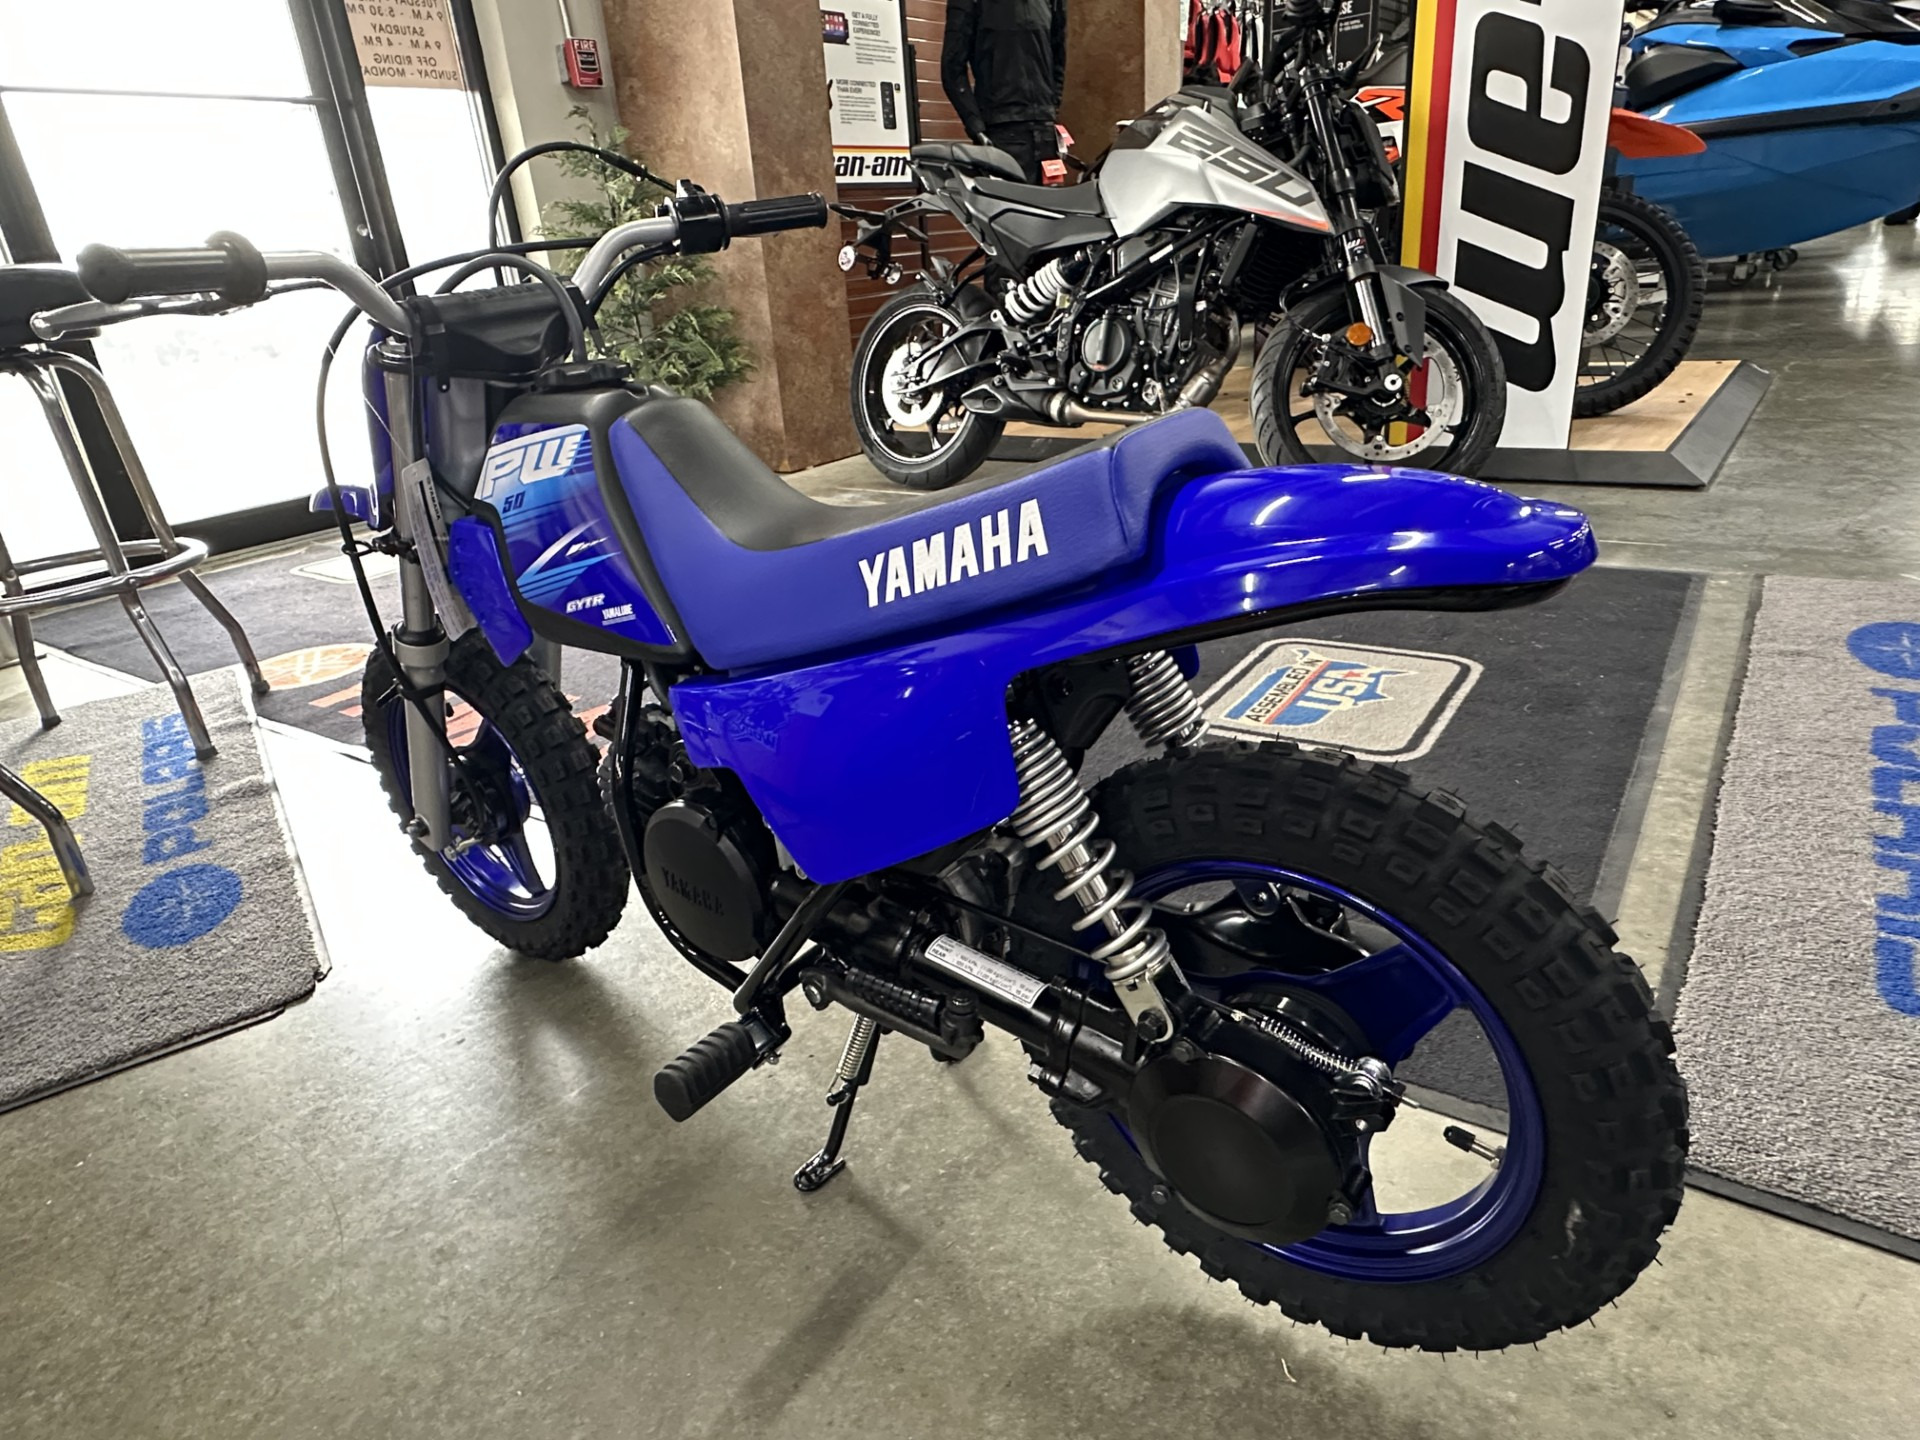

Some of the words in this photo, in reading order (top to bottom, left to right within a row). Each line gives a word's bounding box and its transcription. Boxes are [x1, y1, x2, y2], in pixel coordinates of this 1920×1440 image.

[574, 40, 596, 51] FIRE
[834, 154, 907, 177] an-am
[503, 491, 526, 514] 50
[858, 498, 1049, 608] YAMAHA
[566, 592, 606, 614] GYTR
[602, 603, 634, 620] YAMALUBE
[1245, 667, 1311, 722] ASSEMBLED
[1296, 669, 1377, 712] USA
